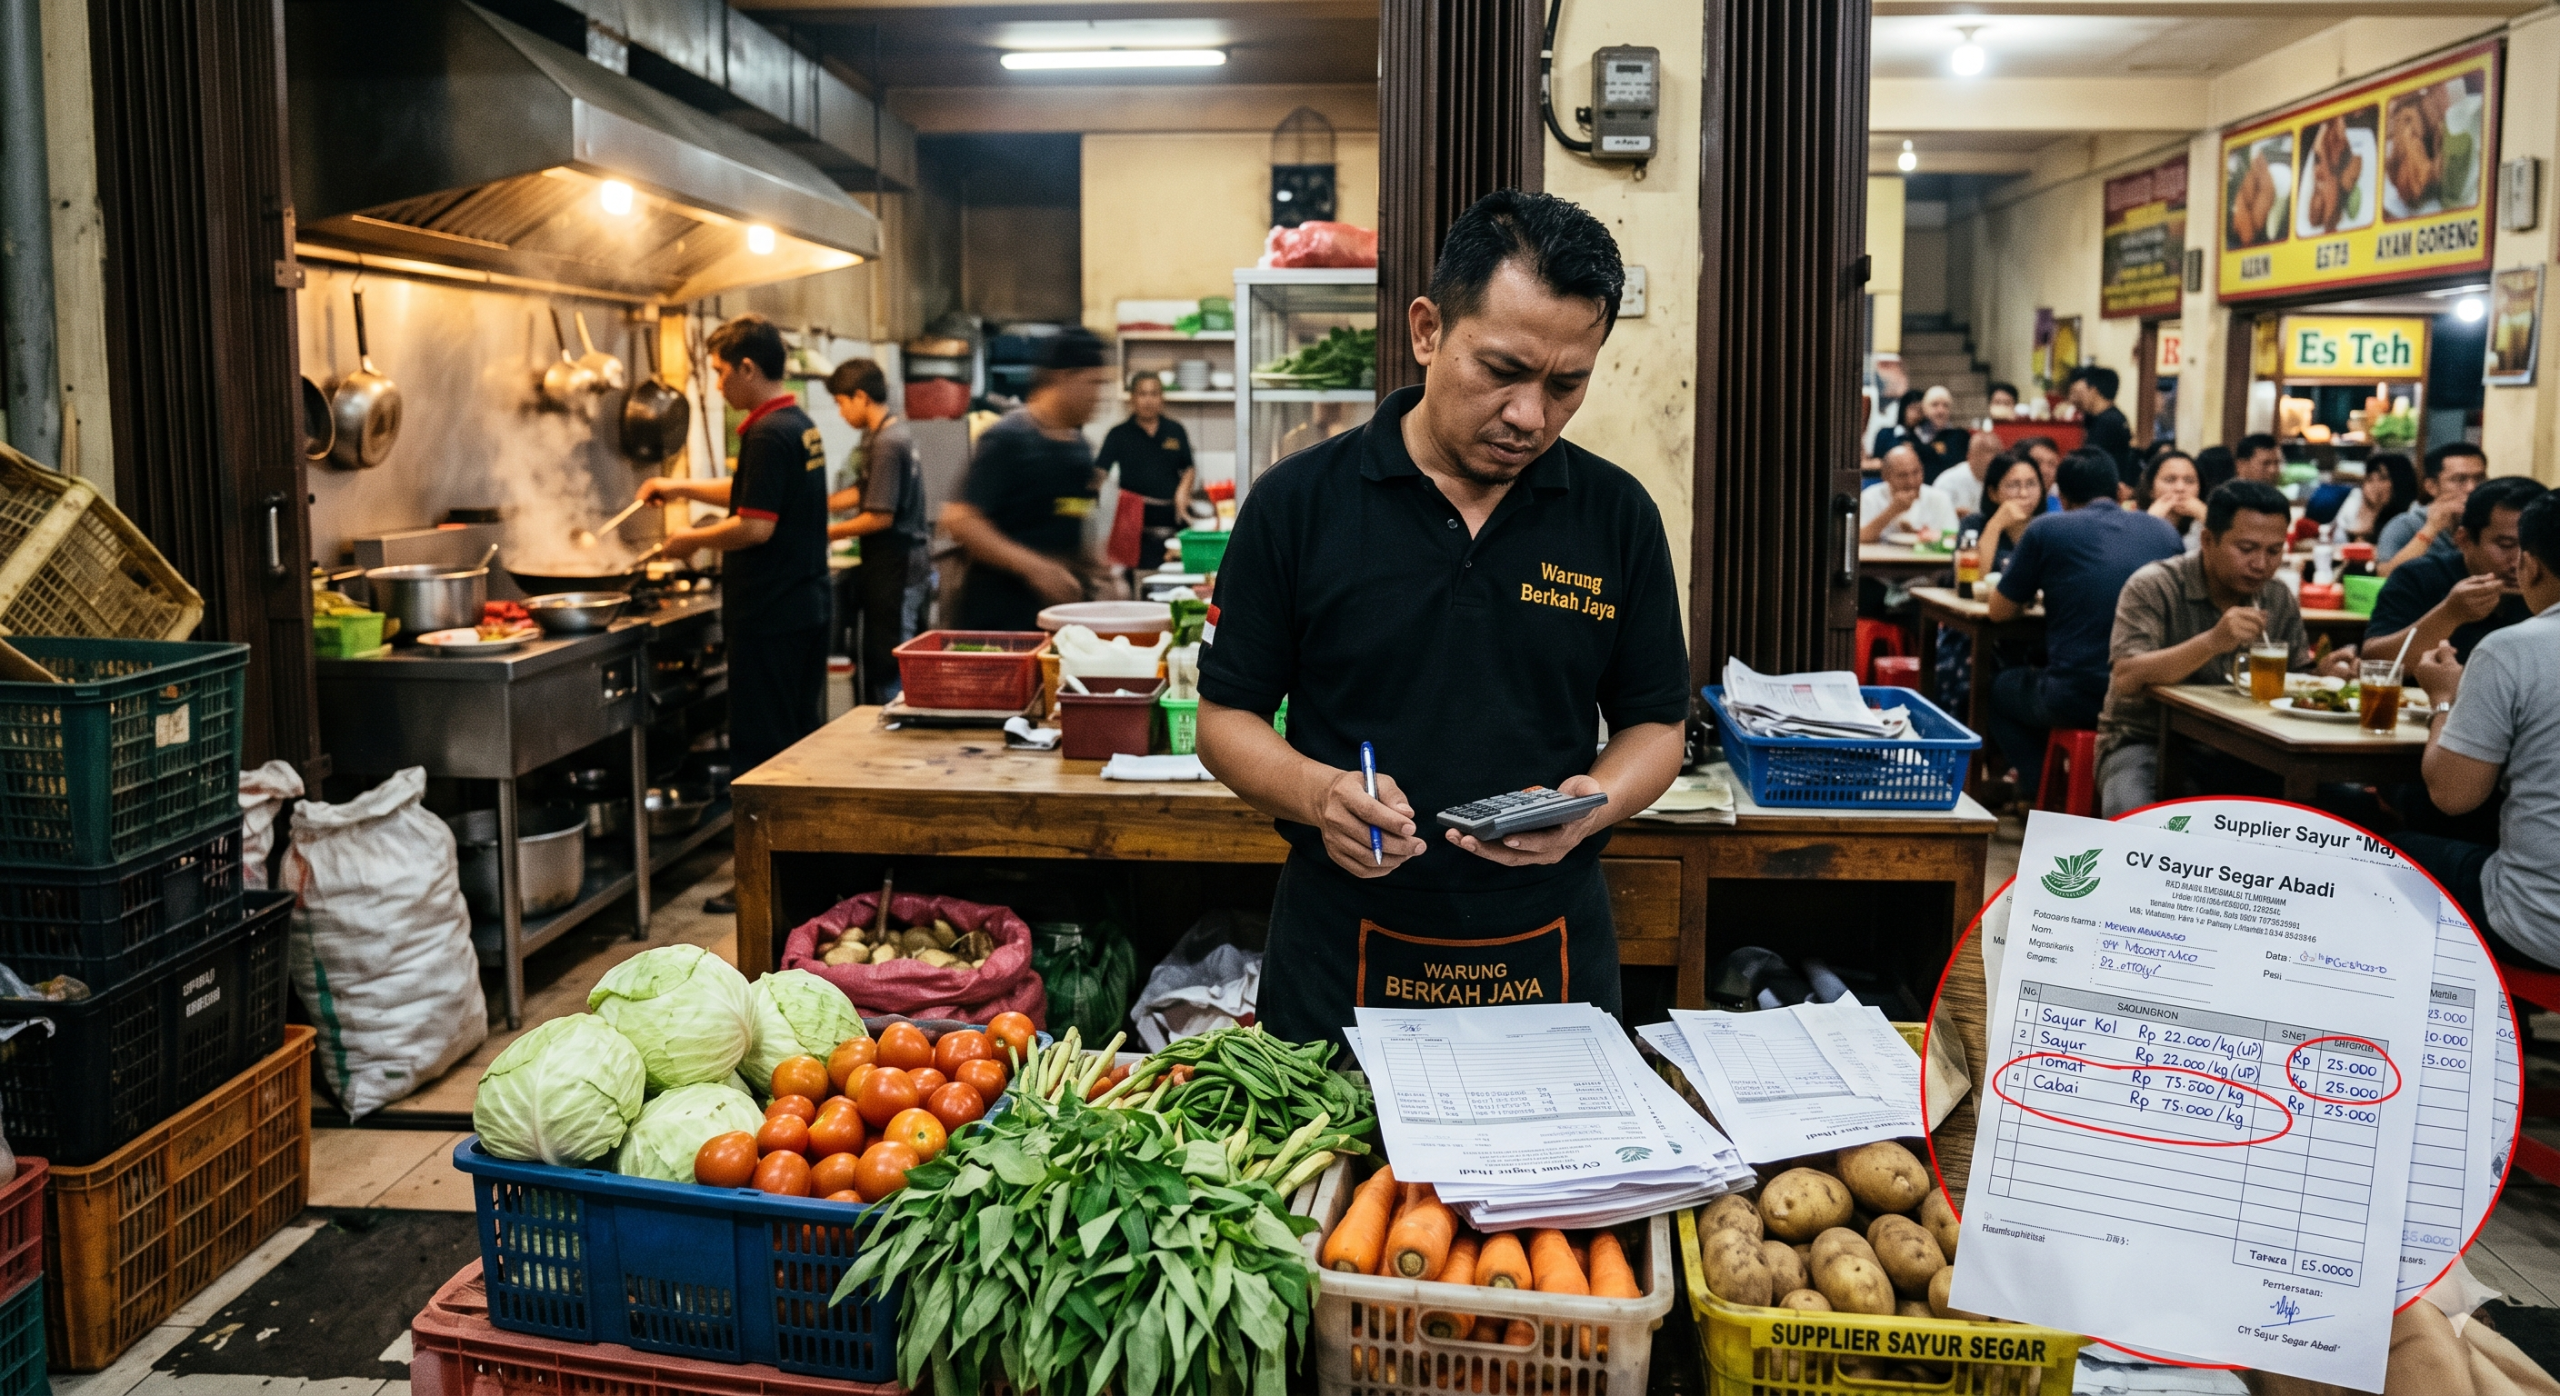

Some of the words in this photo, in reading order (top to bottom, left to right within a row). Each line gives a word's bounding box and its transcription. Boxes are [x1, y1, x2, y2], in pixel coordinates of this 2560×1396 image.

[2376, 231, 2412, 260] AYAM
[2416, 219, 2478, 255] GORENG
[2300, 332, 2336, 364] Es
[2350, 332, 2410, 364] Teh
[1541, 562, 1602, 595] Warung
[1520, 583, 1579, 611] Berkah
[1582, 596, 1616, 621] Jaya
[2214, 814, 2291, 839] Supplier
[2295, 826, 2350, 848] Sayur
[2126, 851, 2154, 869] CV
[2158, 856, 2214, 879] Sayur
[2218, 865, 2275, 889] Segar
[2278, 875, 2335, 898] Abadi
[1424, 962, 1507, 980] WARUNG
[1385, 976, 1481, 1005] BERKAH
[1488, 978, 1543, 1004] JAYA
[2024, 1008, 2029, 1017] 1
[2042, 1008, 2087, 1031] Sayur
[2094, 1017, 2117, 1034] Kol
[2139, 1024, 2156, 1046] Rp
[2019, 1029, 2027, 1038] 2
[2040, 1031, 2087, 1055] Sayur
[2135, 1046, 2154, 1067] Rp
[2036, 1051, 2087, 1073] Tomat
[2132, 1070, 2151, 1089] Rp
[2292, 1049, 2311, 1070] Rp
[2327, 1058, 2377, 1077] 25.000
[2033, 1074, 2079, 1094] Cabai
[2130, 1091, 2149, 1111] Rp
[2325, 1080, 2378, 1100] 25.000
[2288, 1095, 2305, 1115] Rp
[2324, 1104, 2376, 1123] 25.000
[1771, 1322, 1880, 1351] SUPPLIER
[1887, 1331, 1962, 1357] SAYUR
[1970, 1336, 2046, 1362] SEGAR
